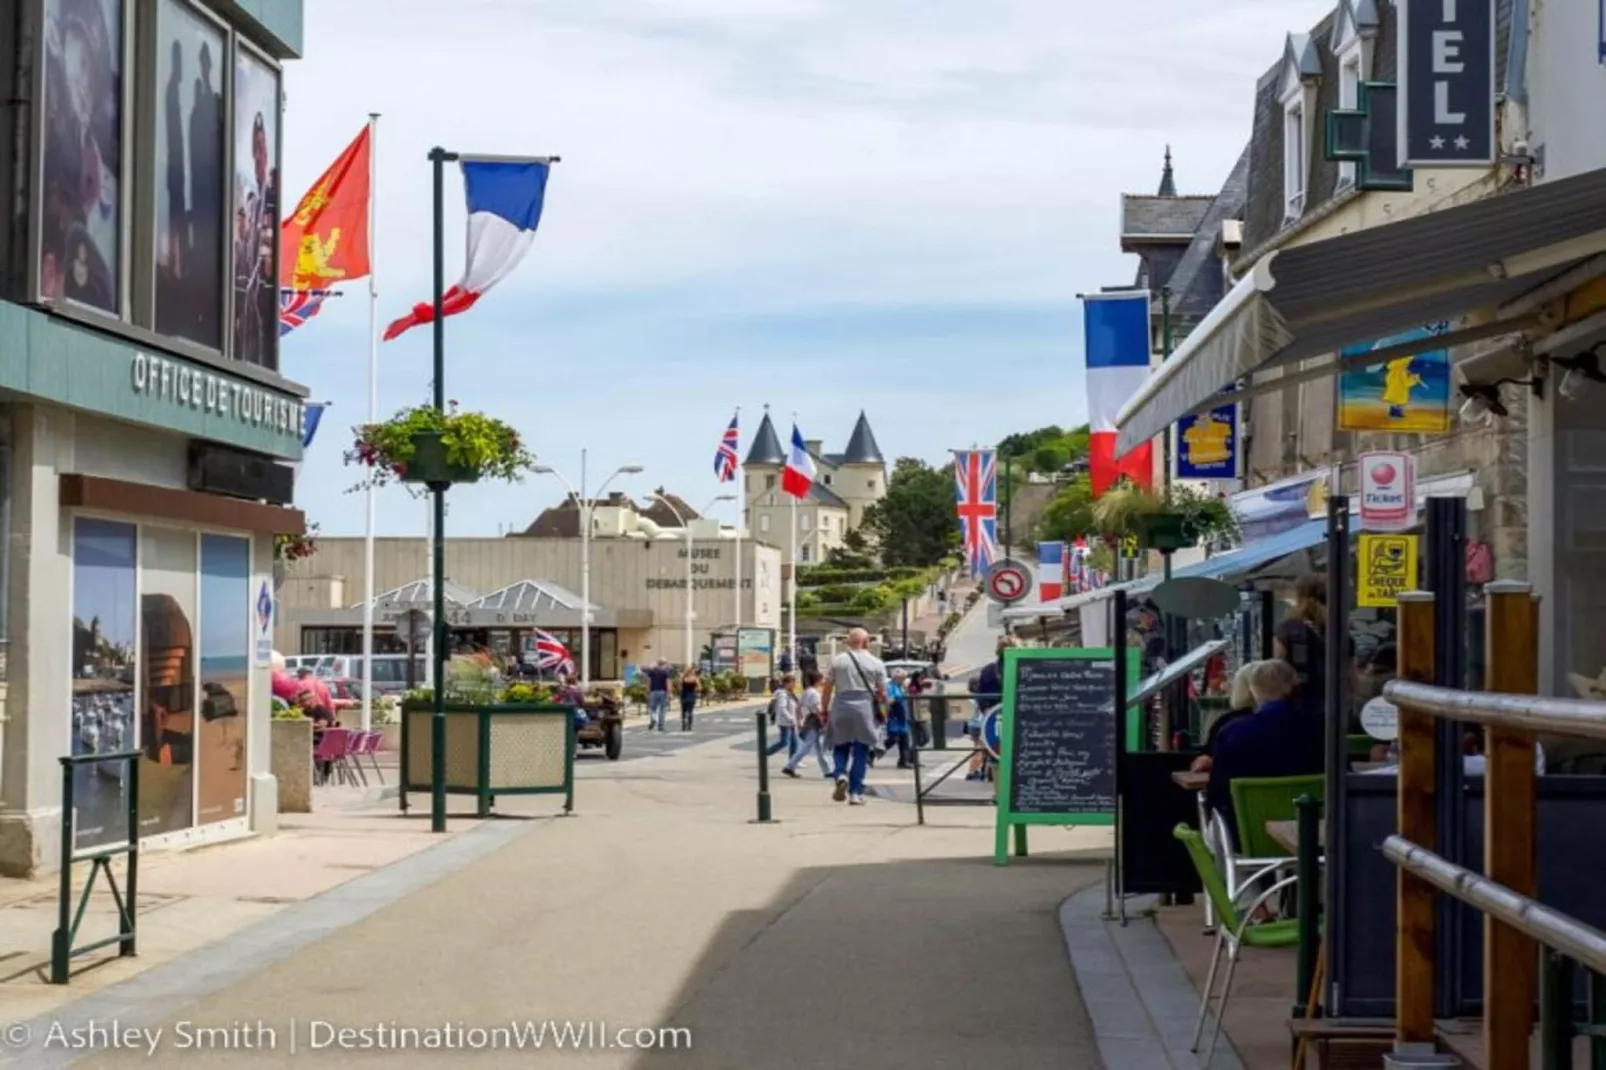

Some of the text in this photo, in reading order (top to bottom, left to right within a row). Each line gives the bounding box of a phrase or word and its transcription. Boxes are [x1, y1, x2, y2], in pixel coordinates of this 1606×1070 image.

[133, 352, 306, 437] OFFICE DE TOURISME
[1366, 493, 1402, 503] Ticket
[678, 549, 720, 559] MUSEE
[690, 563, 709, 574] DU
[512, 613, 538, 623] DAY
